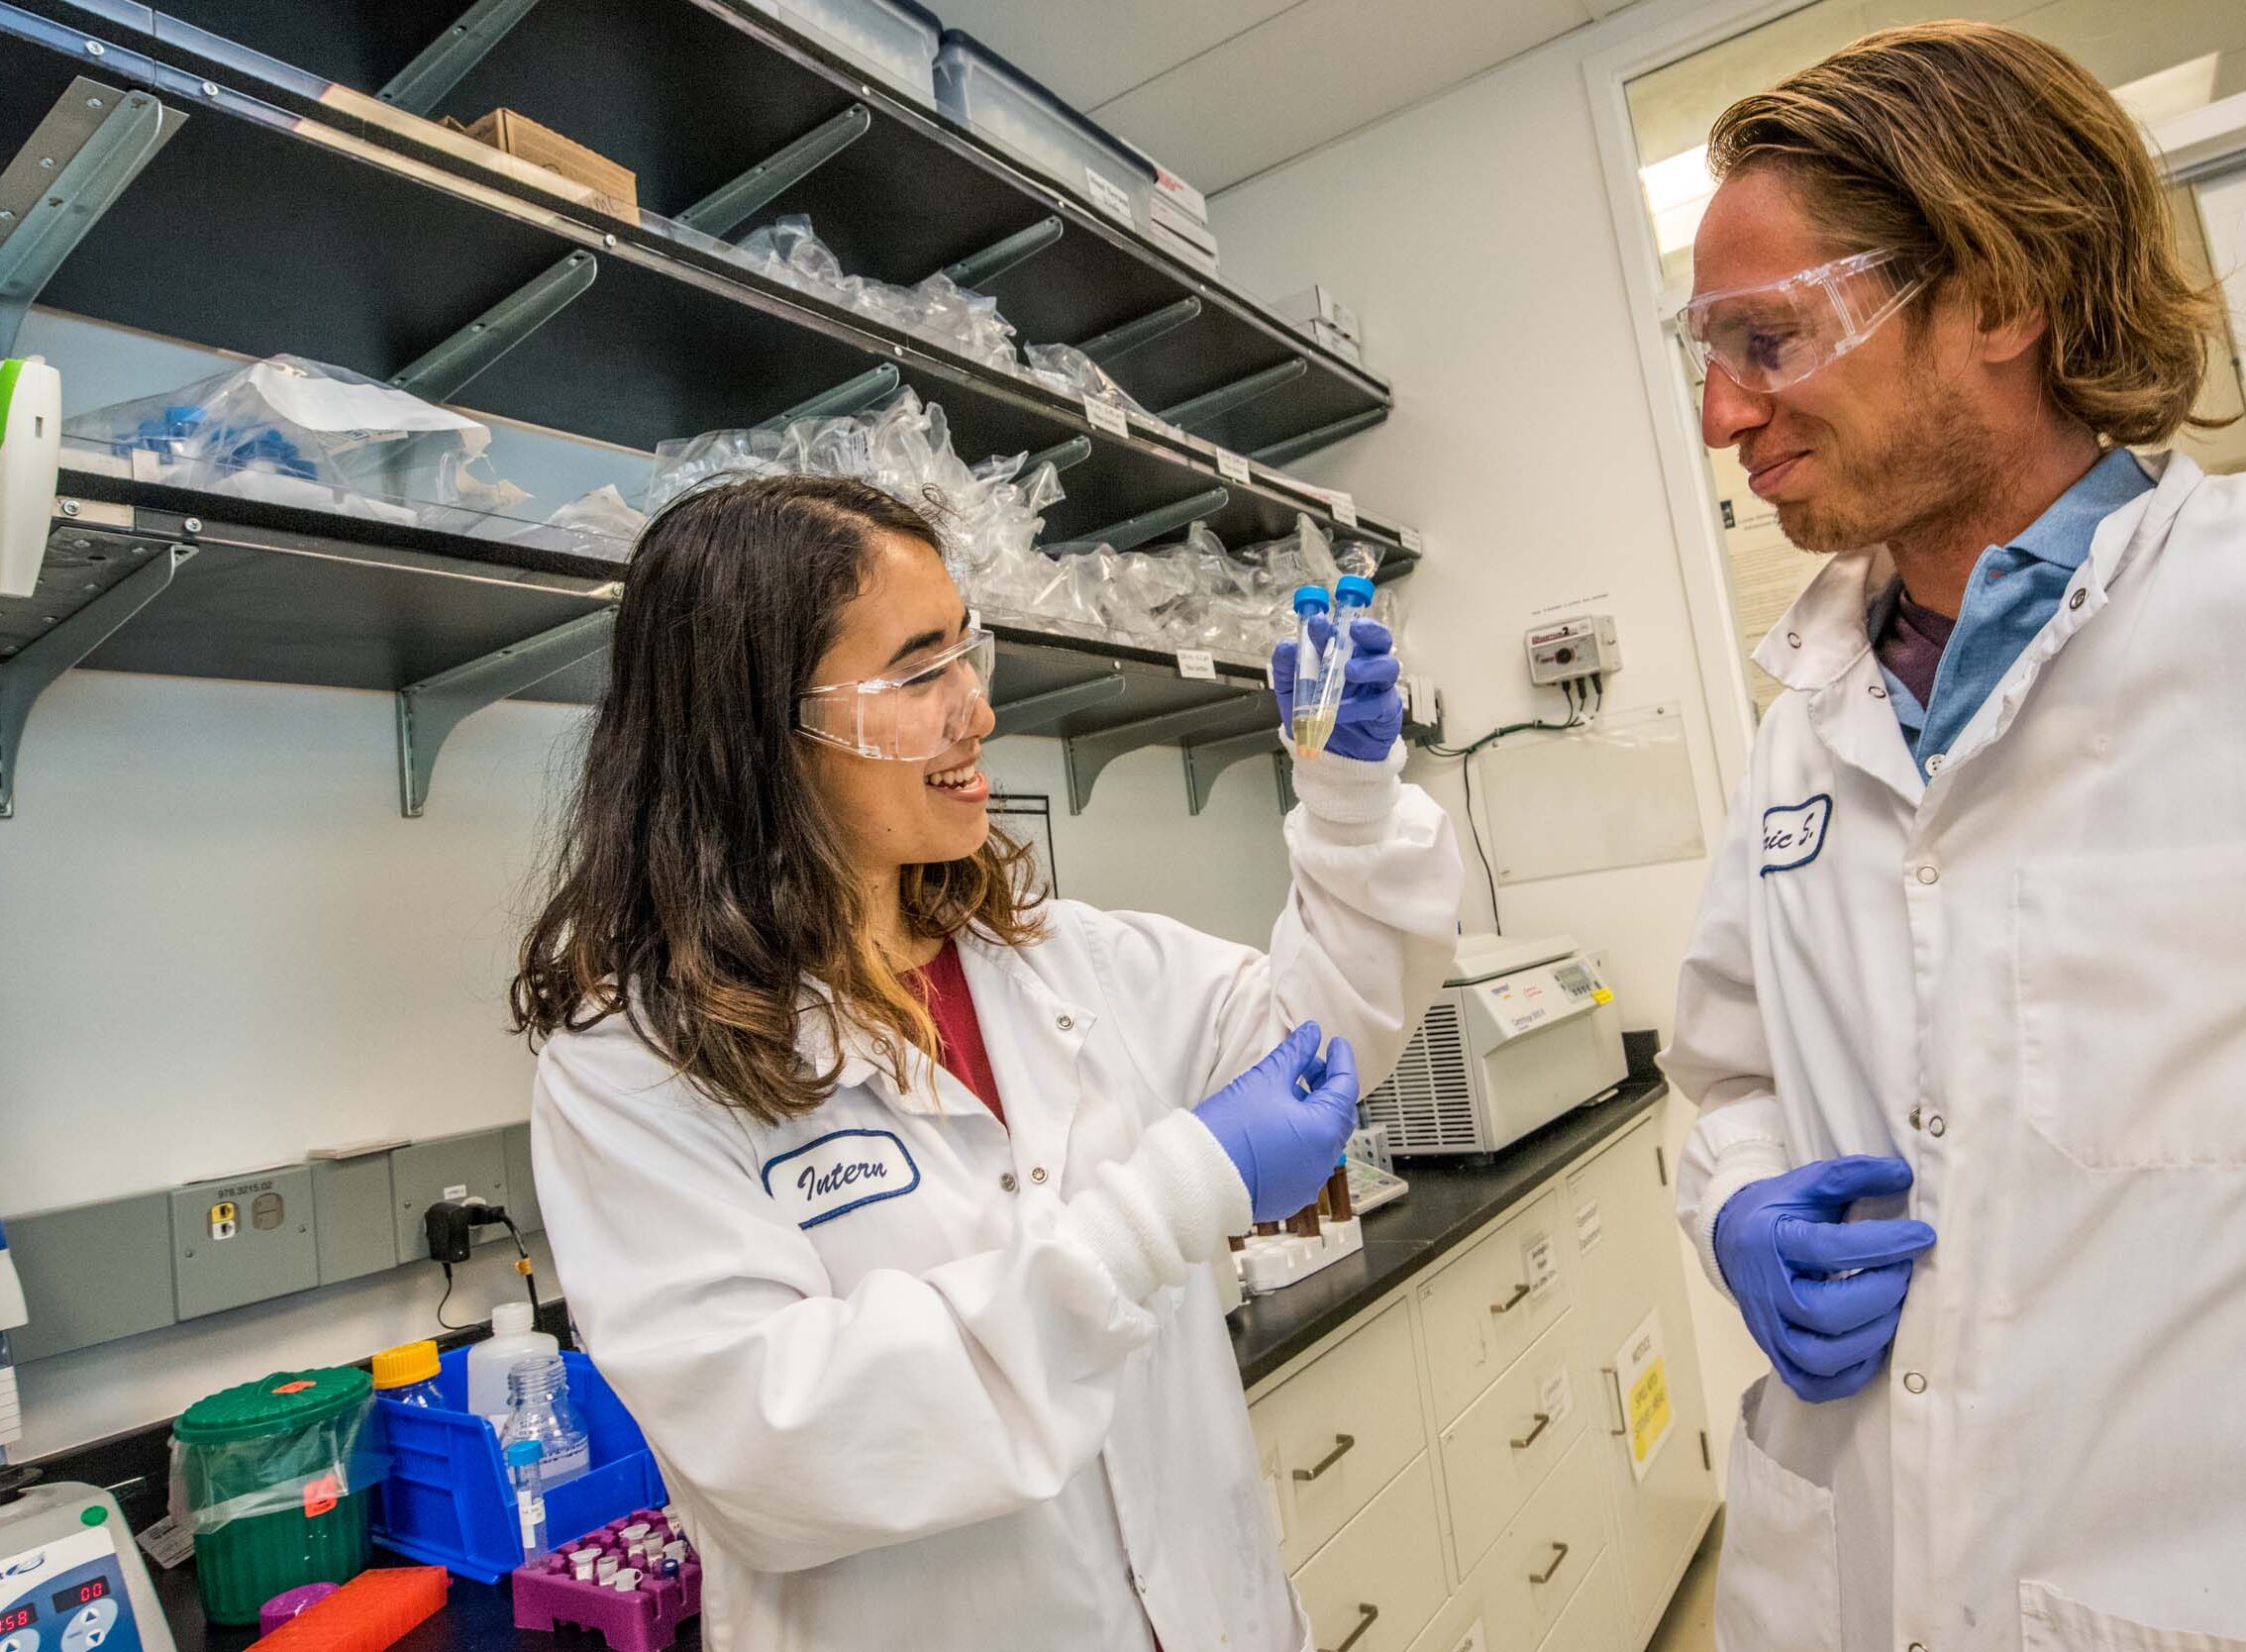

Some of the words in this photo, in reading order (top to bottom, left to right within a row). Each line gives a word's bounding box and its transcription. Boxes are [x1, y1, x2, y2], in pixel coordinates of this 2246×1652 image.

[1797, 812, 1815, 846] S.
[796, 1162, 887, 1201] Intern
[80, 1583, 102, 1602] 00
